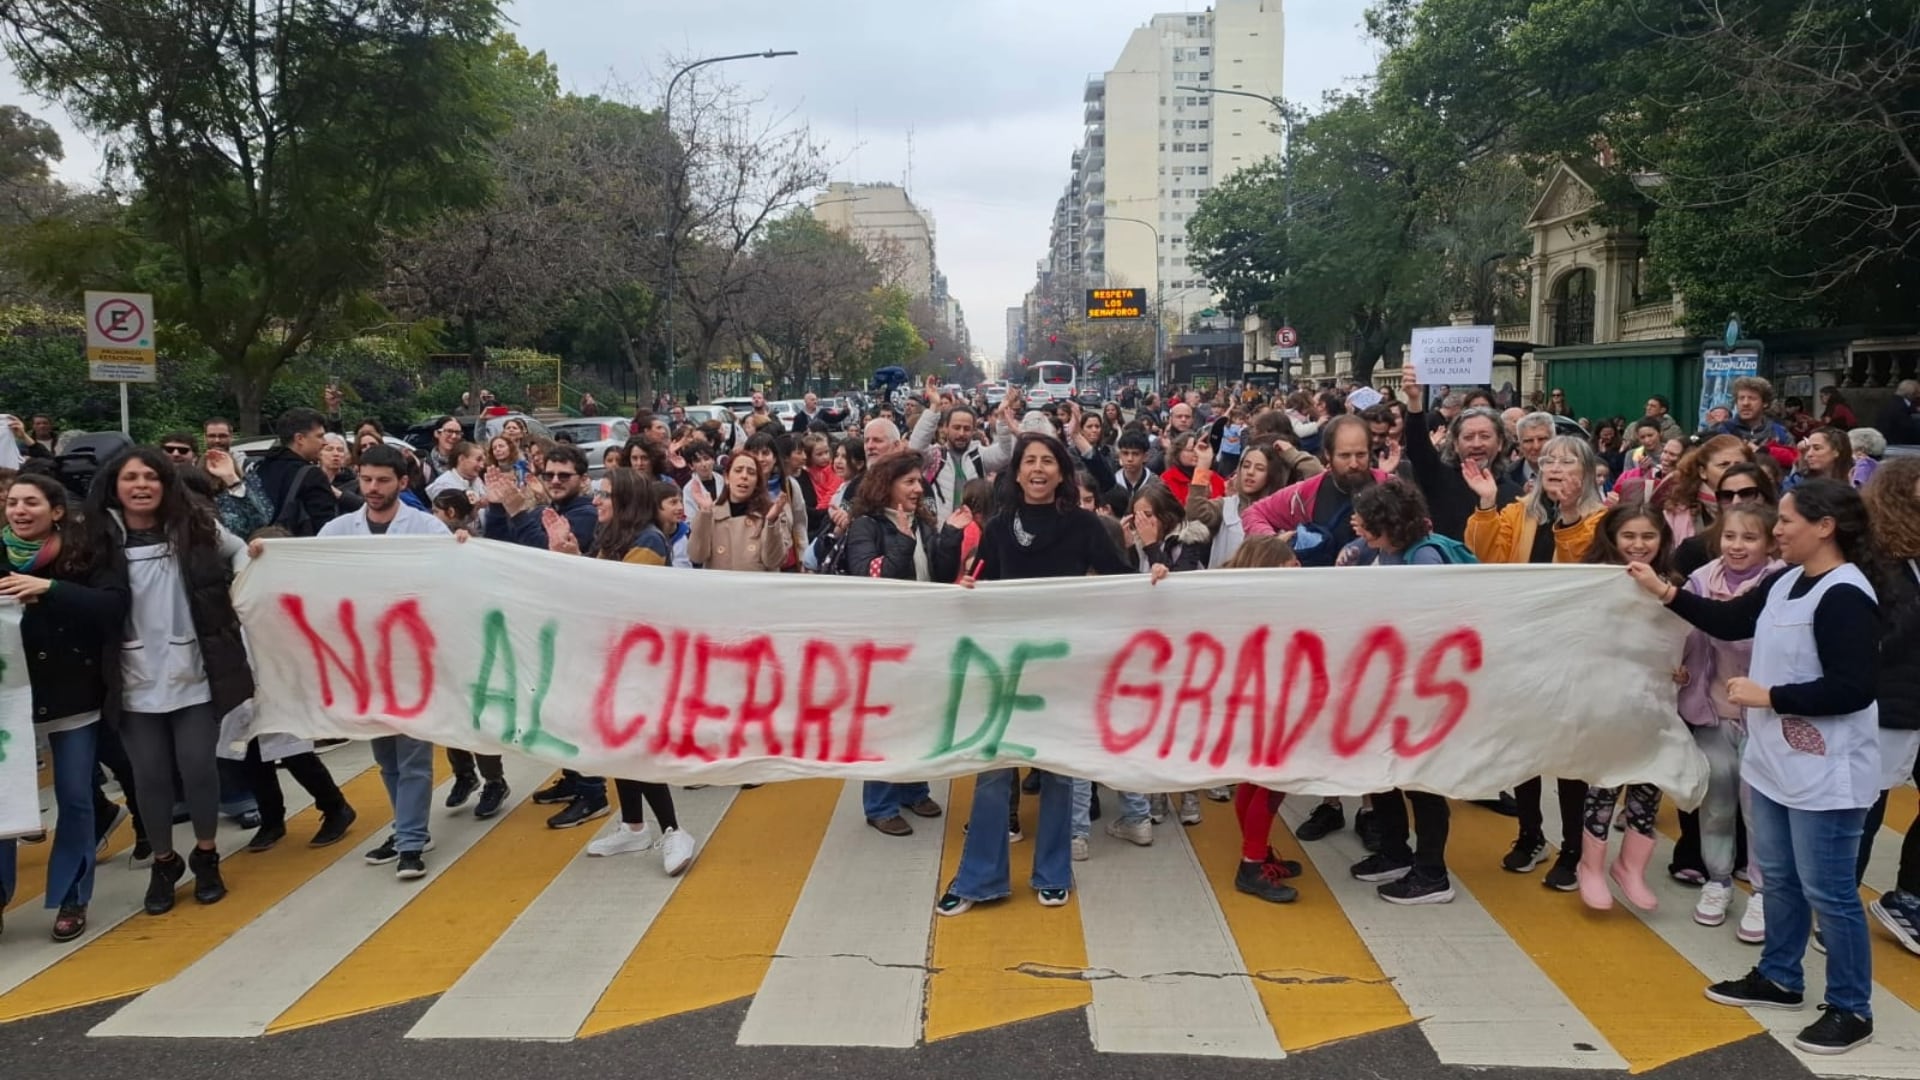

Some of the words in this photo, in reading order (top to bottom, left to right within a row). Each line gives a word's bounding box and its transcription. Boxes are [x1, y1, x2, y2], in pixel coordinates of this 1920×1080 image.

[1093, 290, 1133, 299] RESPETA
[1104, 300, 1122, 308] LOS
[1088, 308, 1139, 317] SEMAFOROS
[111, 311, 128, 330] E
[1437, 346, 1475, 354] GRADOS
[1424, 357, 1465, 365] ESCUELA
[1427, 367, 1446, 375] SAN
[1447, 367, 1471, 375] JUAN
[278, 592, 438, 720] NO
[471, 608, 580, 757] AL
[590, 622, 913, 765] CIERRE
[928, 636, 1071, 761] DE
[1094, 624, 1484, 769] GRADOS
